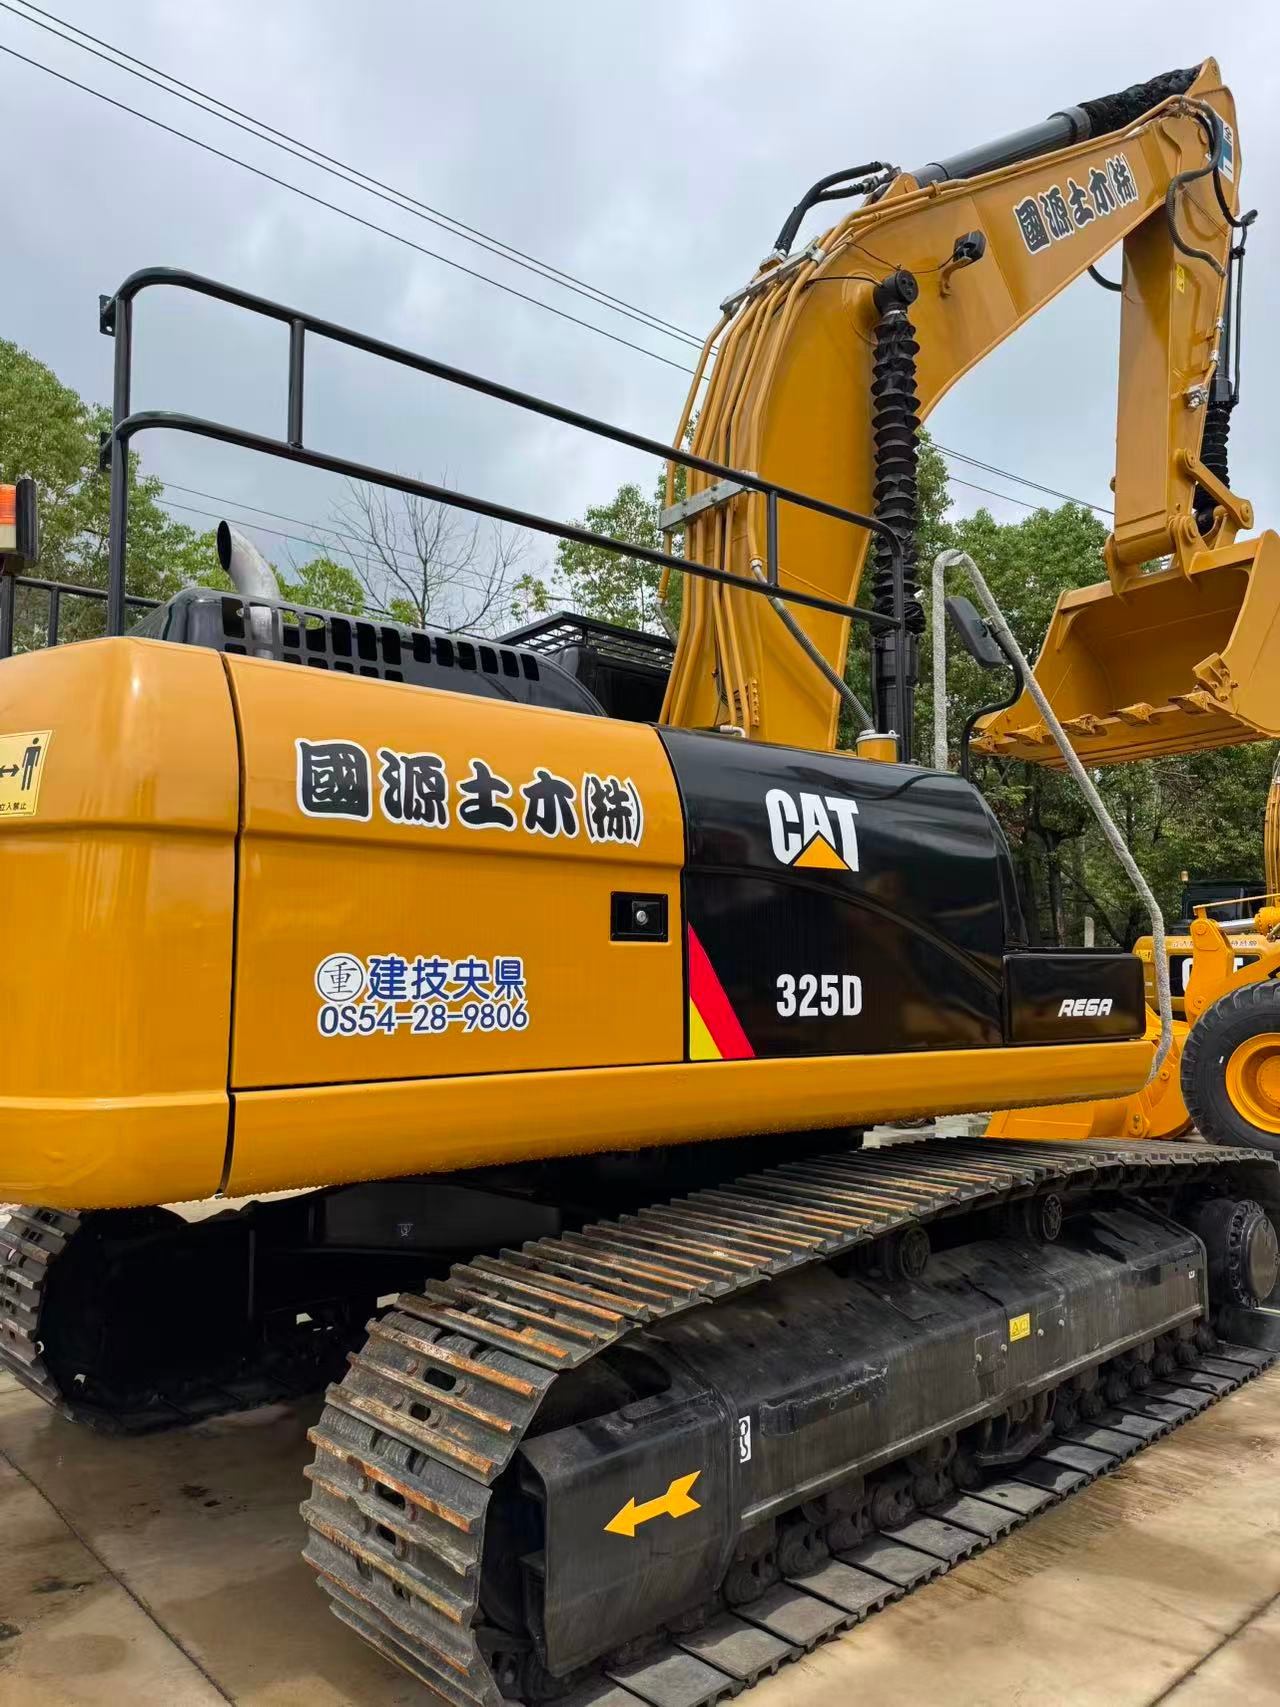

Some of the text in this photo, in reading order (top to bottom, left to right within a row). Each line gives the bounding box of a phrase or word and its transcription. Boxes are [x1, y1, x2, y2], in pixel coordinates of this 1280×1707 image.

[765, 788, 859, 872] CAT
[775, 973, 863, 1018] 325D
[1057, 997, 1113, 1018] REGA
